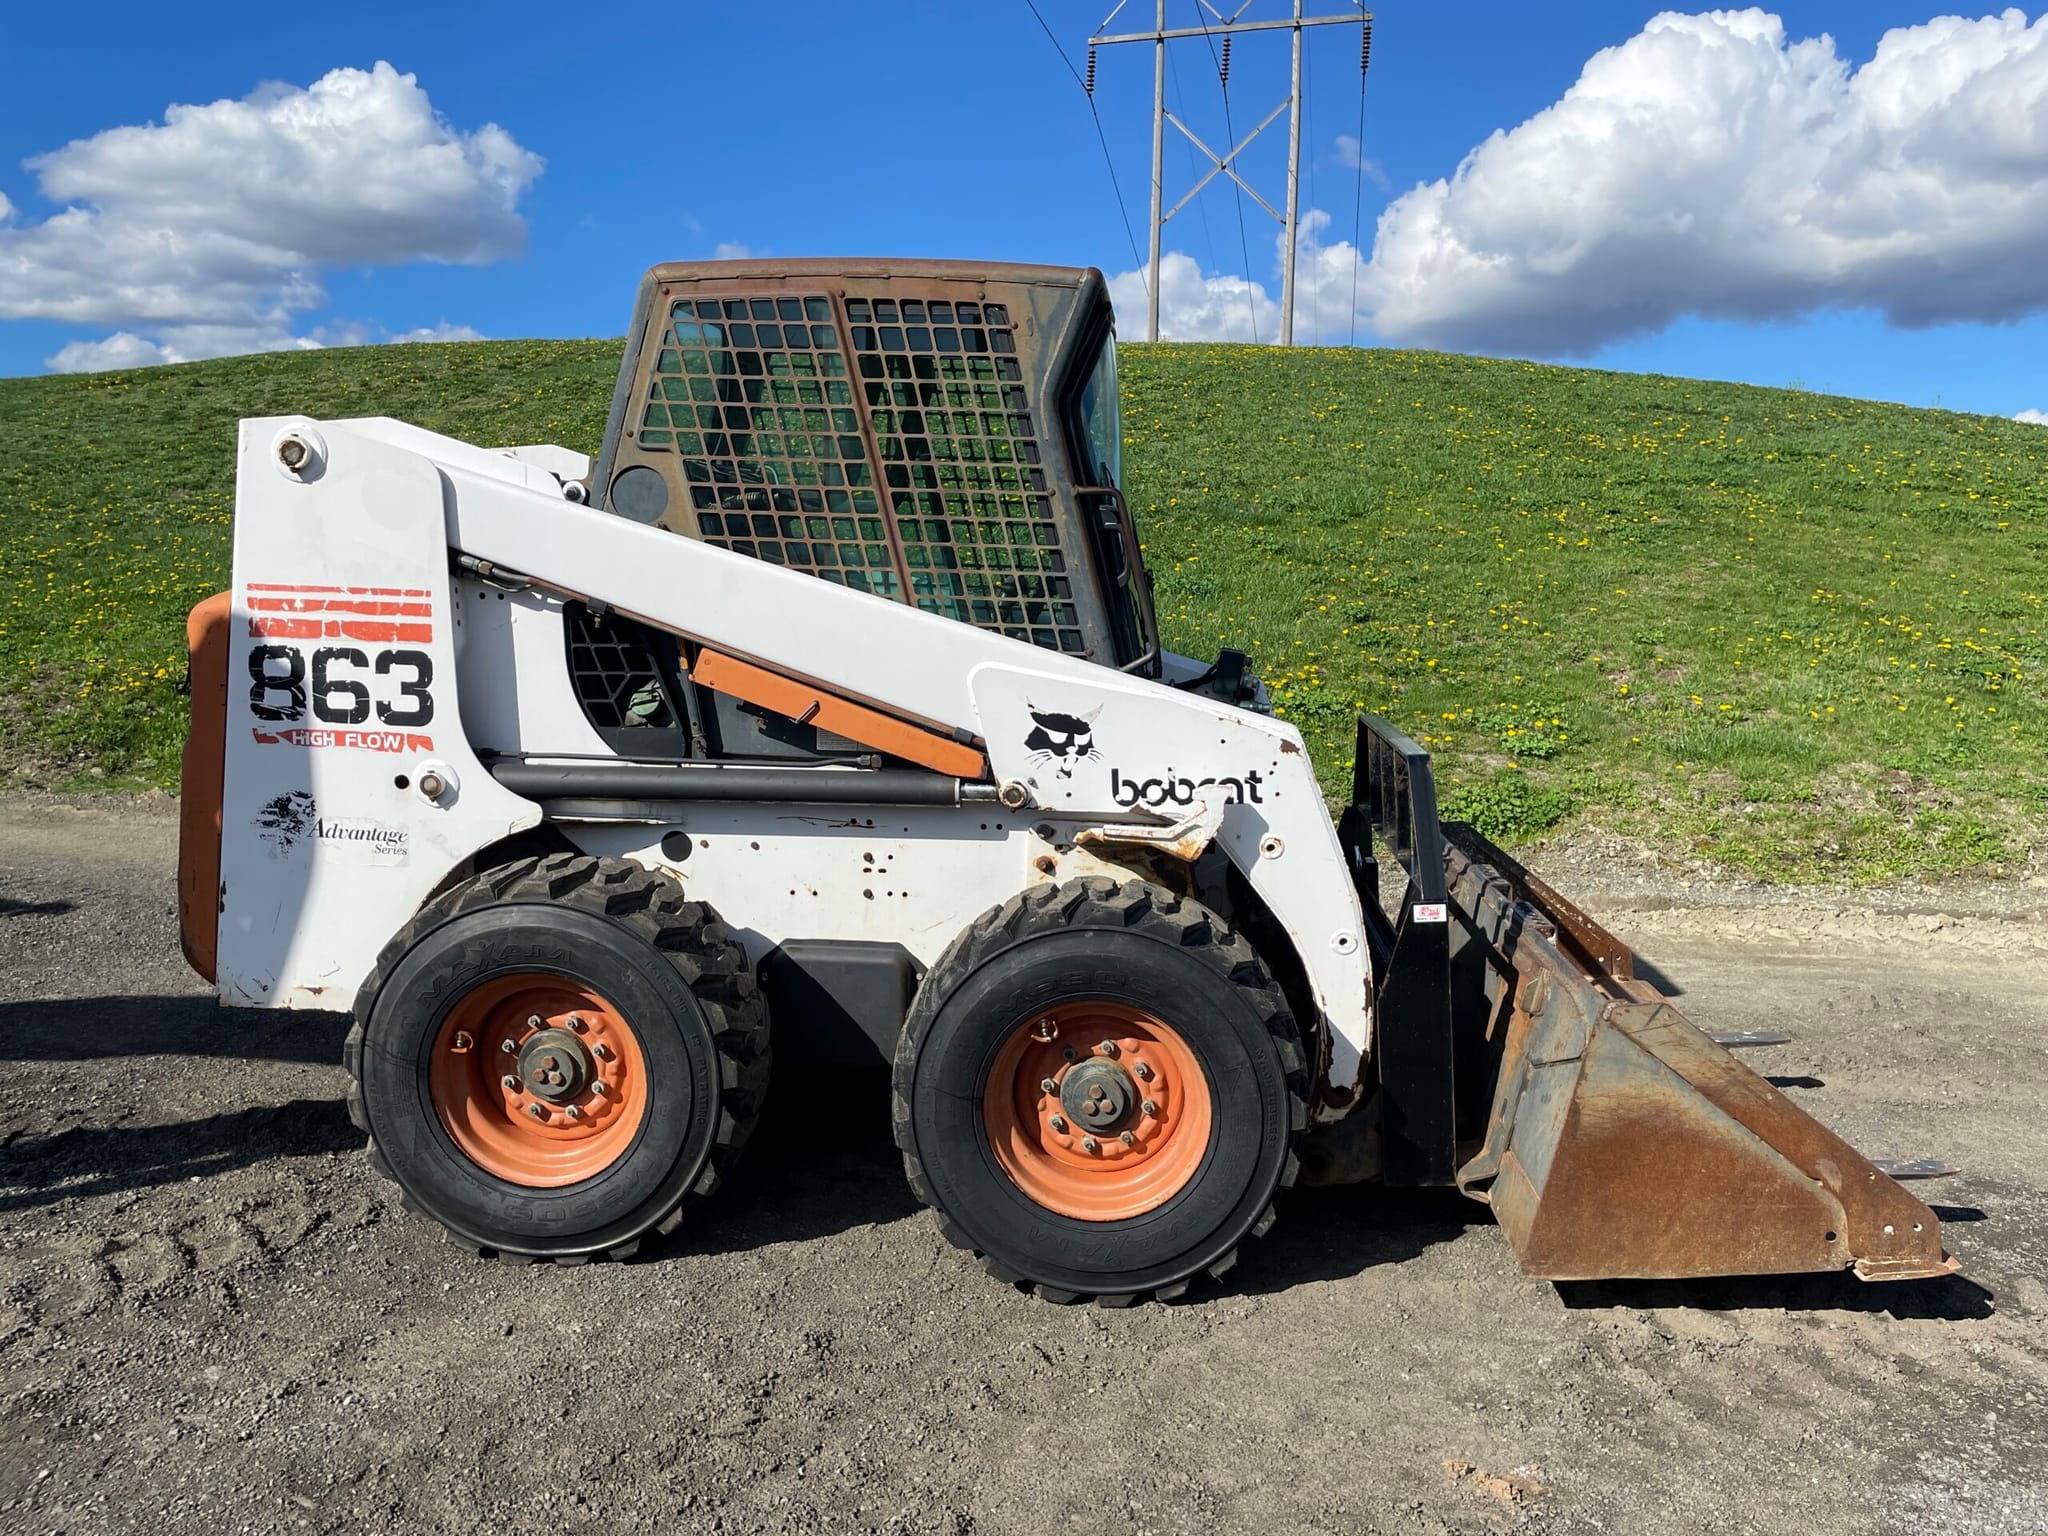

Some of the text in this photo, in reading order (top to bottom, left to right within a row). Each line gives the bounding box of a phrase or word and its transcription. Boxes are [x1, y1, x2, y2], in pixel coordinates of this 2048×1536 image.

[248, 644, 434, 727] 863
[292, 732, 401, 749] HIGH FLOW
[306, 816, 409, 846] Advantage
[374, 843, 408, 856] Series
